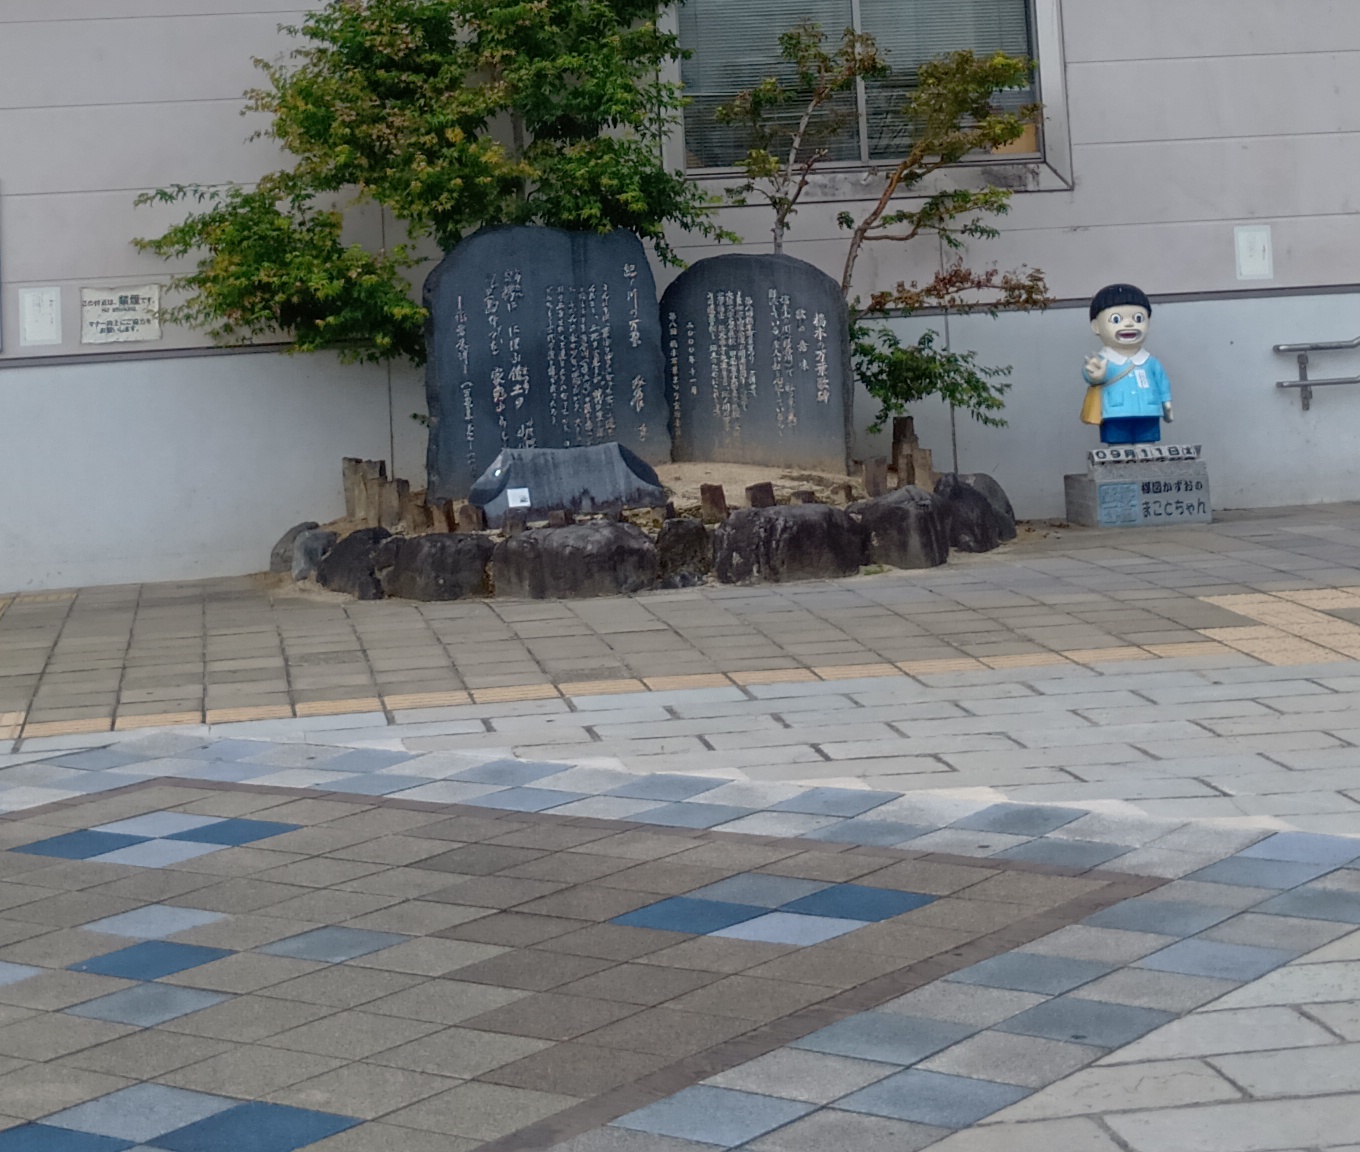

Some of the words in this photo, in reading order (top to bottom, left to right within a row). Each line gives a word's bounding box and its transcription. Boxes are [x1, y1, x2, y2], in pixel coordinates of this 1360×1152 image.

[1141, 498, 1207, 518] まことちゃん
